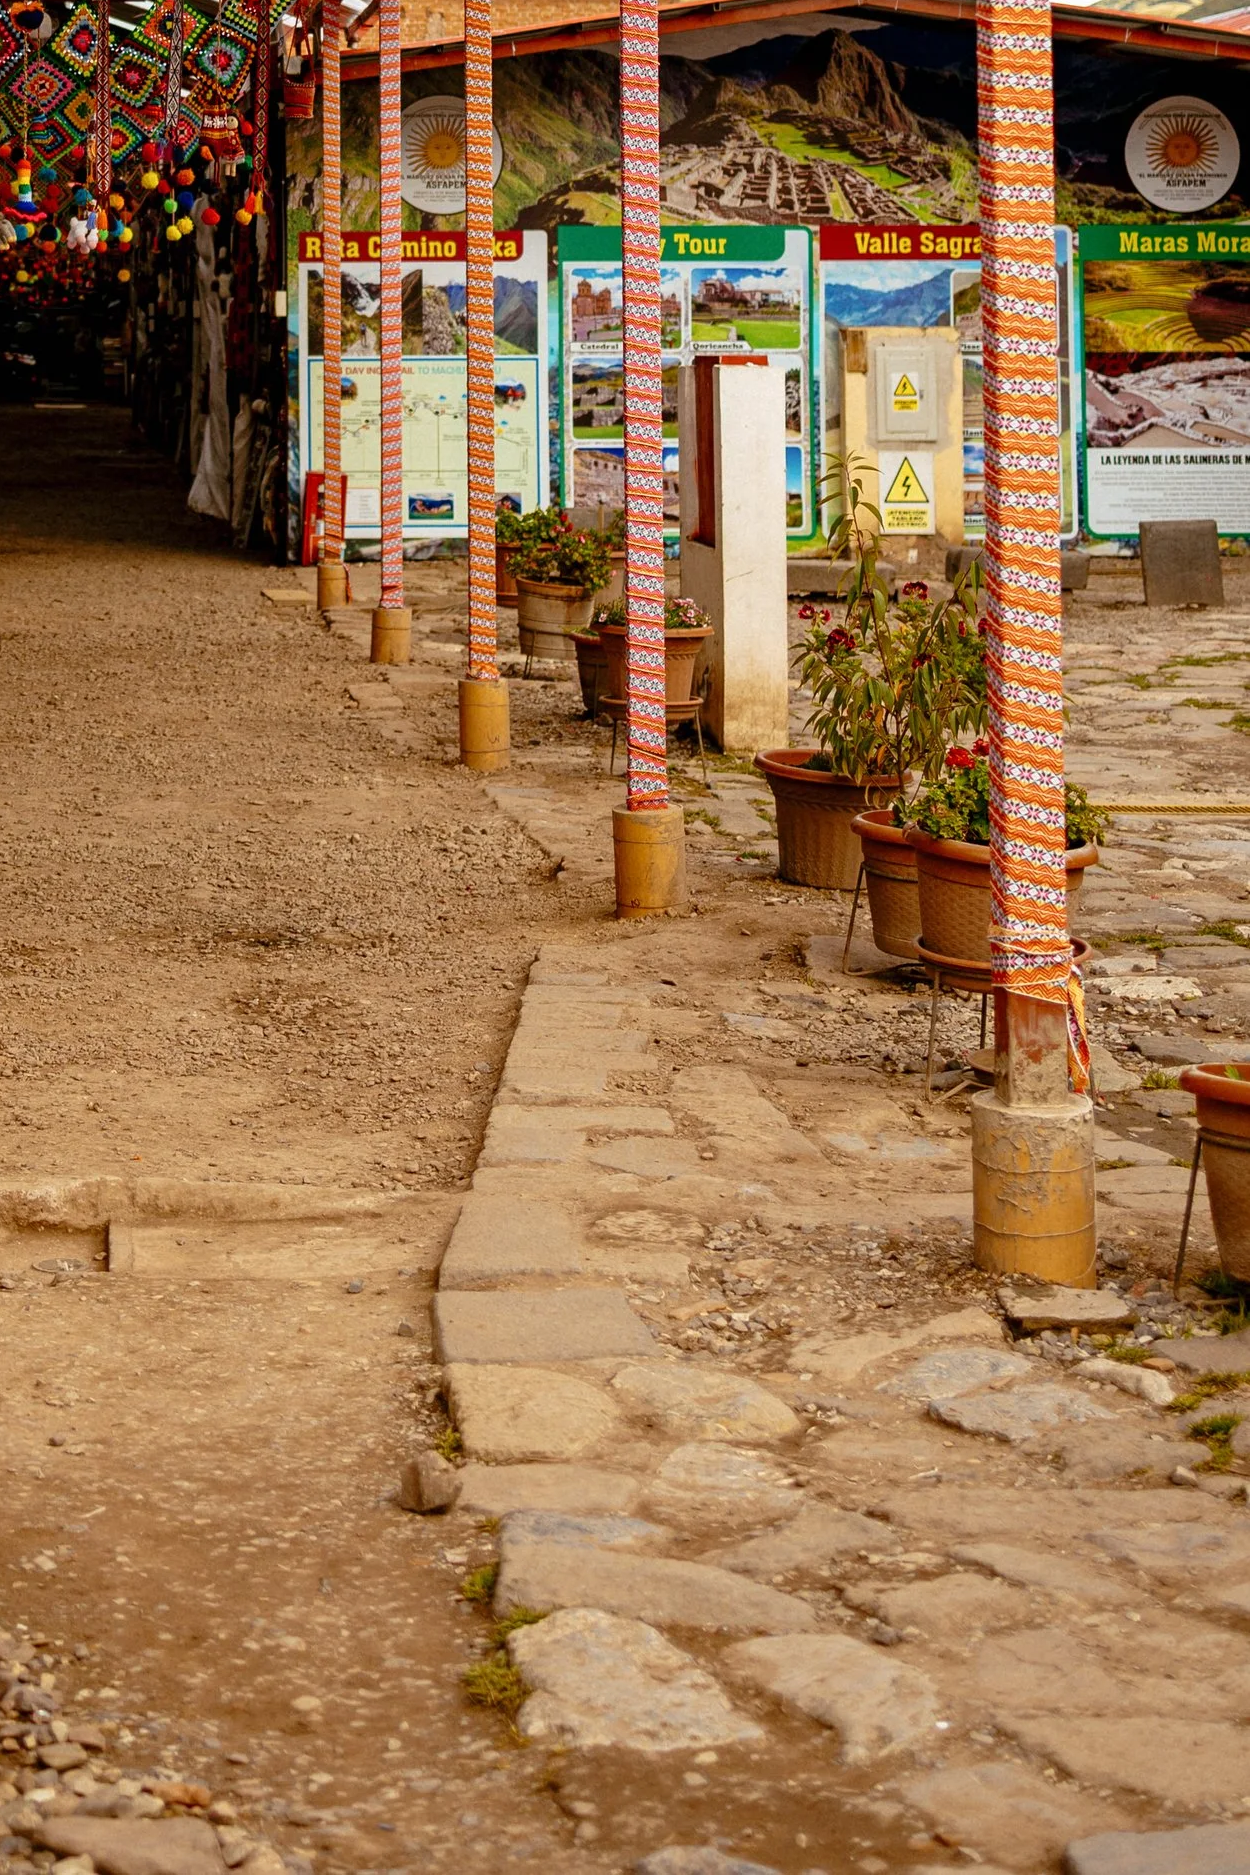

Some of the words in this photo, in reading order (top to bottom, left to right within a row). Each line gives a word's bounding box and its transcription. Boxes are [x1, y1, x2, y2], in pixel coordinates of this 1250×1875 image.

[1166, 179, 1207, 187] ASFAPEM
[305, 237, 360, 258] Rta
[368, 236, 457, 258] Cmino
[674, 233, 727, 254] Tour
[854, 232, 912, 254] Valle
[919, 231, 982, 259] Sagra
[1119, 231, 1189, 253] Maras
[1197, 231, 1250, 253] Mora
[692, 342, 744, 351] Qoricancha
[345, 367, 365, 375] DAY
[366, 367, 381, 375] INC
[417, 366, 430, 374] TO
[1100, 455, 1112, 465] LA
[1113, 455, 1151, 465] LEYENDA
[1152, 455, 1163, 465] DE
[1165, 455, 1181, 465] LAS
[1183, 455, 1230, 465] SALINERAS
[1232, 455, 1243, 465] DE
